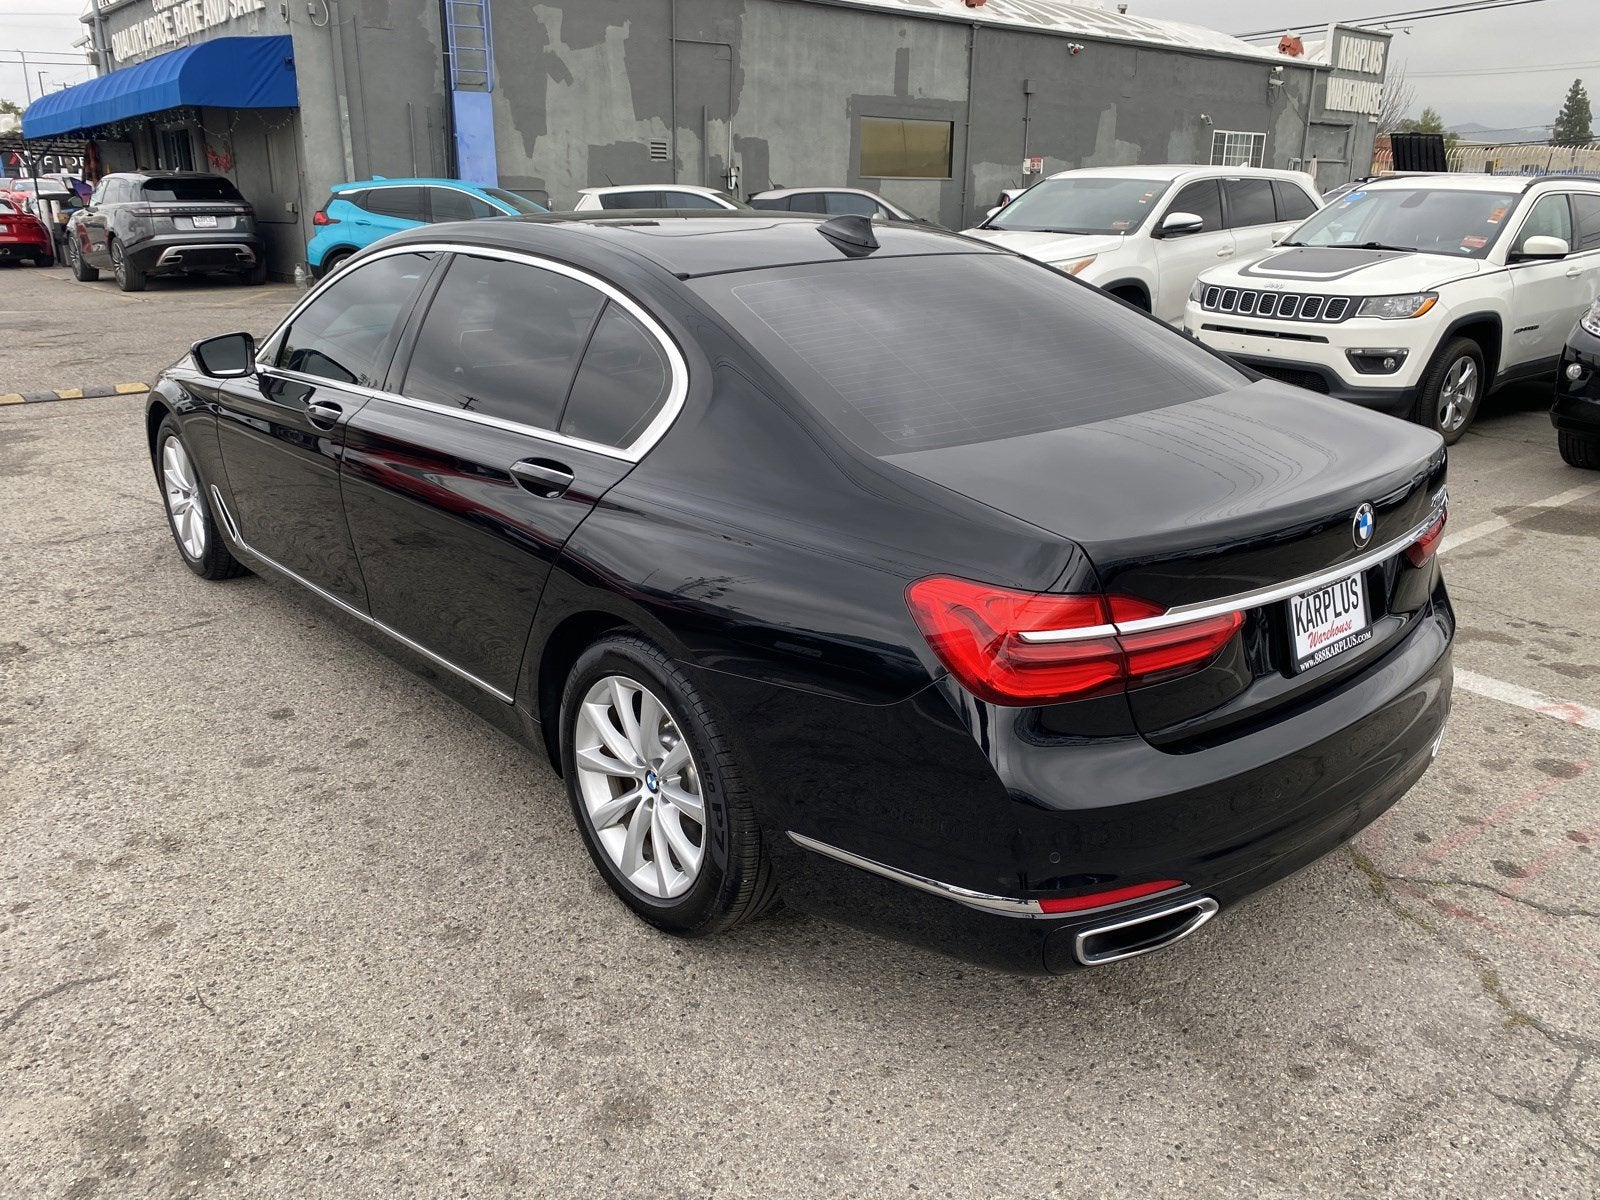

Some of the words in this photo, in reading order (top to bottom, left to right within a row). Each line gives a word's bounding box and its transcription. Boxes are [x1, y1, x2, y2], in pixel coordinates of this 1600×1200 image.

[203, 0, 229, 28] AND
[1338, 35, 1385, 75] KARPLUS
[1325, 76, 1384, 115] WAREHOUSE
[1294, 578, 1359, 637] KARPLUS
[1307, 620, 1353, 649] Warehouse
[711, 803, 725, 855] P7
